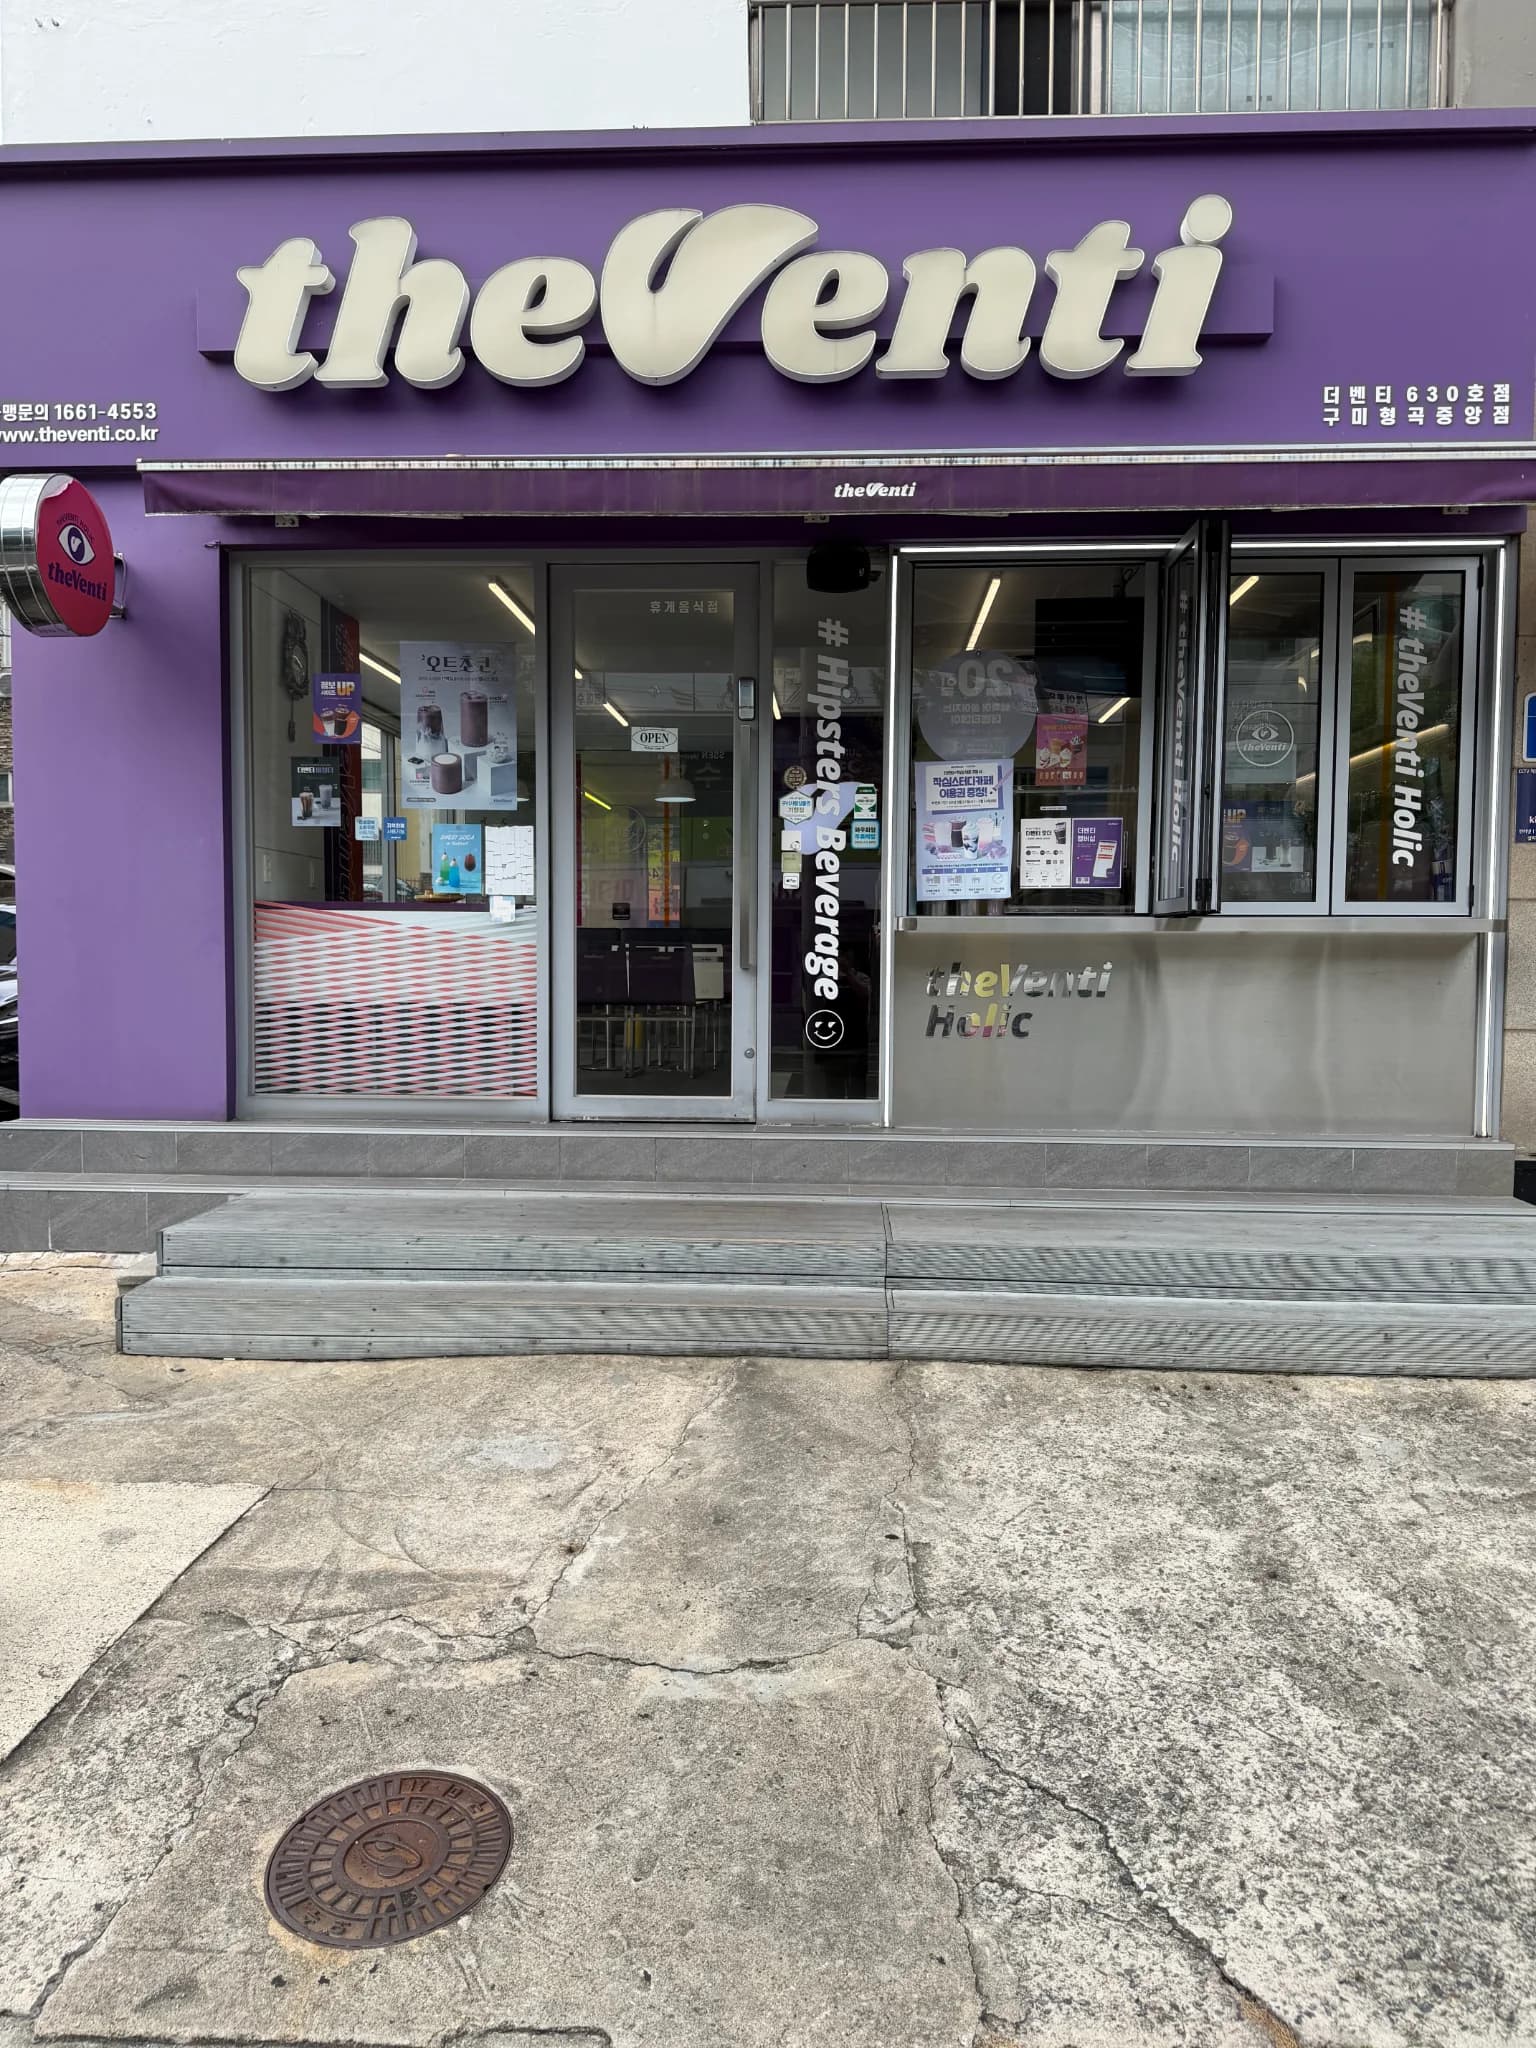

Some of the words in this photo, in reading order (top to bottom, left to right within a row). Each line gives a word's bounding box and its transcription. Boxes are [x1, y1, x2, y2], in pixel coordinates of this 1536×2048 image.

[234, 194, 1234, 391] theVenti
[1323, 385, 1392, 404] 더벤티
[1406, 384, 1510, 403] 630호점
[0, 403, 49, 421] 맹문의
[54, 403, 157, 421] 1661-4553
[1323, 406, 1510, 426] 구미형곡중앙점
[834, 482, 917, 498] theVenti
[48, 561, 108, 600] theVenti
[649, 600, 719, 614] 휴게음식점
[337, 681, 355, 696] UP
[1394, 637, 1428, 778] theVenti
[640, 733, 669, 743] OPEN
[807, 655, 848, 816] Hipsters
[939, 788, 966, 799] 이용권
[1392, 784, 1423, 868] Holic
[805, 826, 847, 1001] Beverage
[926, 961, 1113, 998] theVenti
[925, 1002, 1034, 1038] Holic
